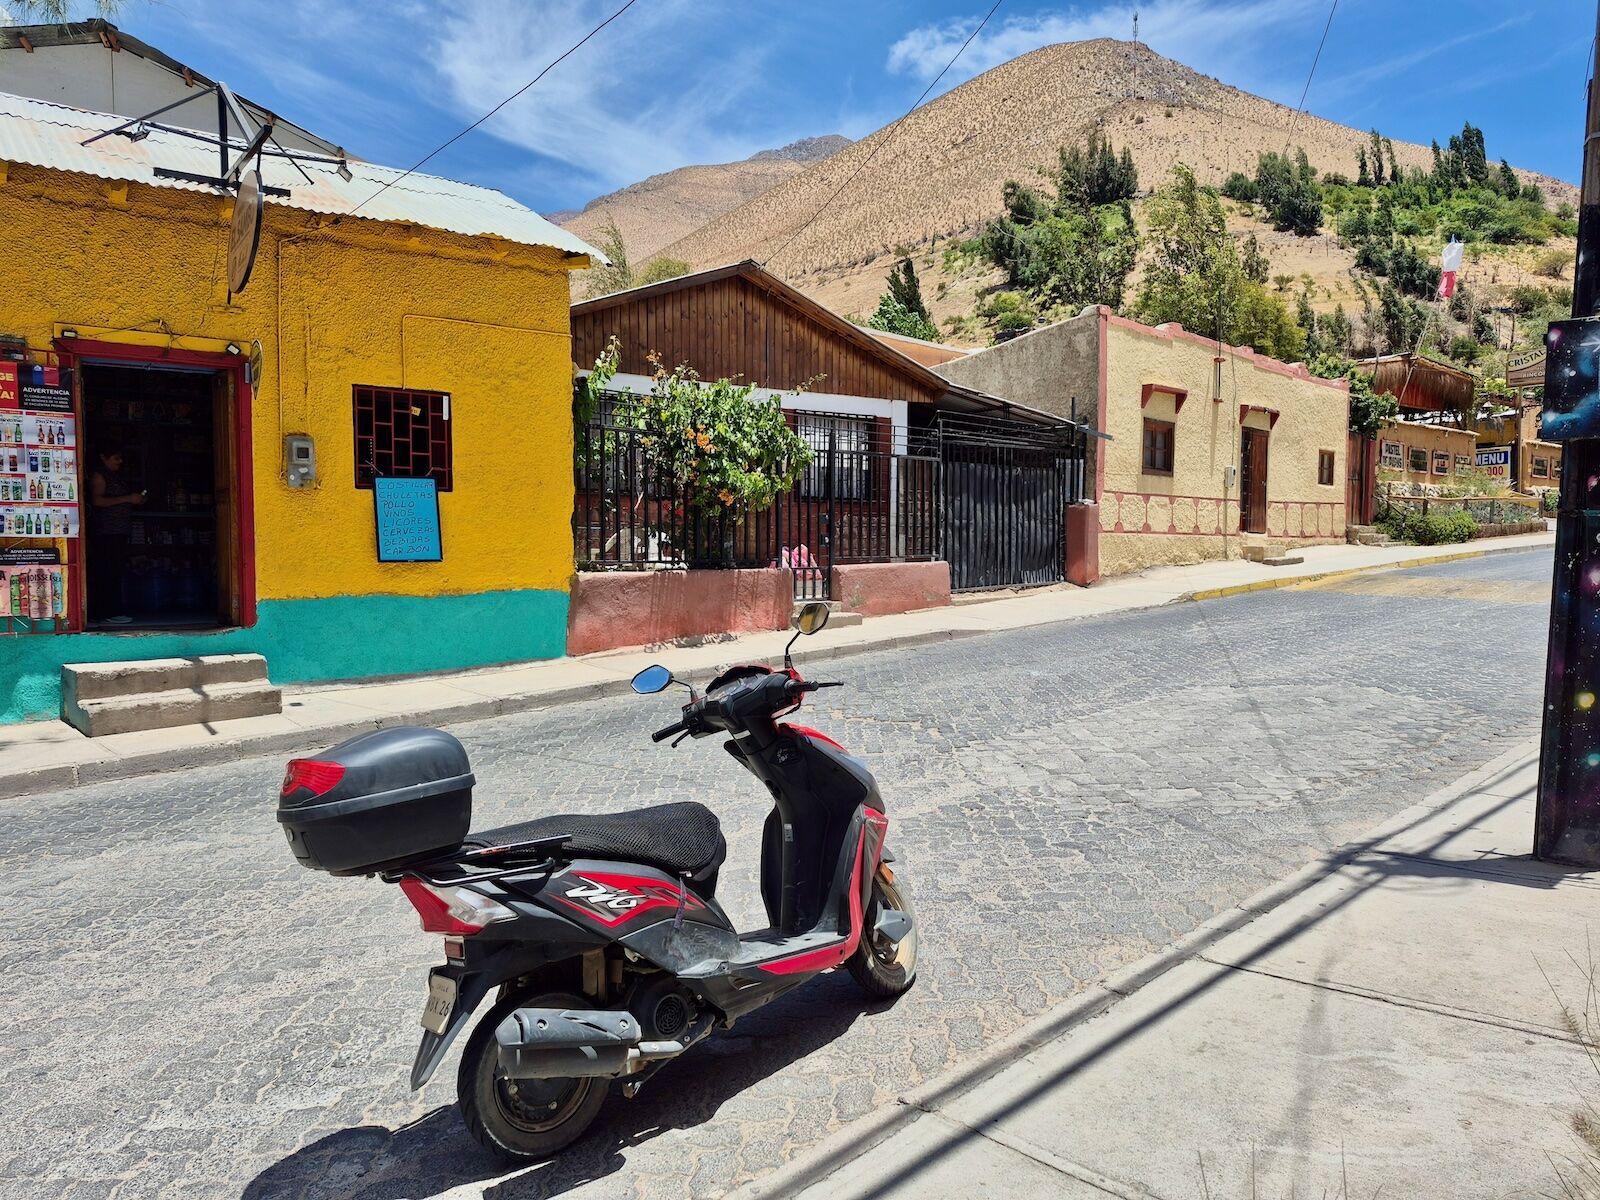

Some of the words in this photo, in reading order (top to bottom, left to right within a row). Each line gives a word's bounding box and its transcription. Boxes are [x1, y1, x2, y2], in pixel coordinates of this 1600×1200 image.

[1508, 350, 1546, 368] CRISTAL
[23, 387, 70, 395] ADVERTENCIA
[1476, 452, 1505, 466] MENU
[383, 500, 415, 509] POLLO
[383, 509, 415, 518] VINOS
[383, 517, 432, 528] LICORES
